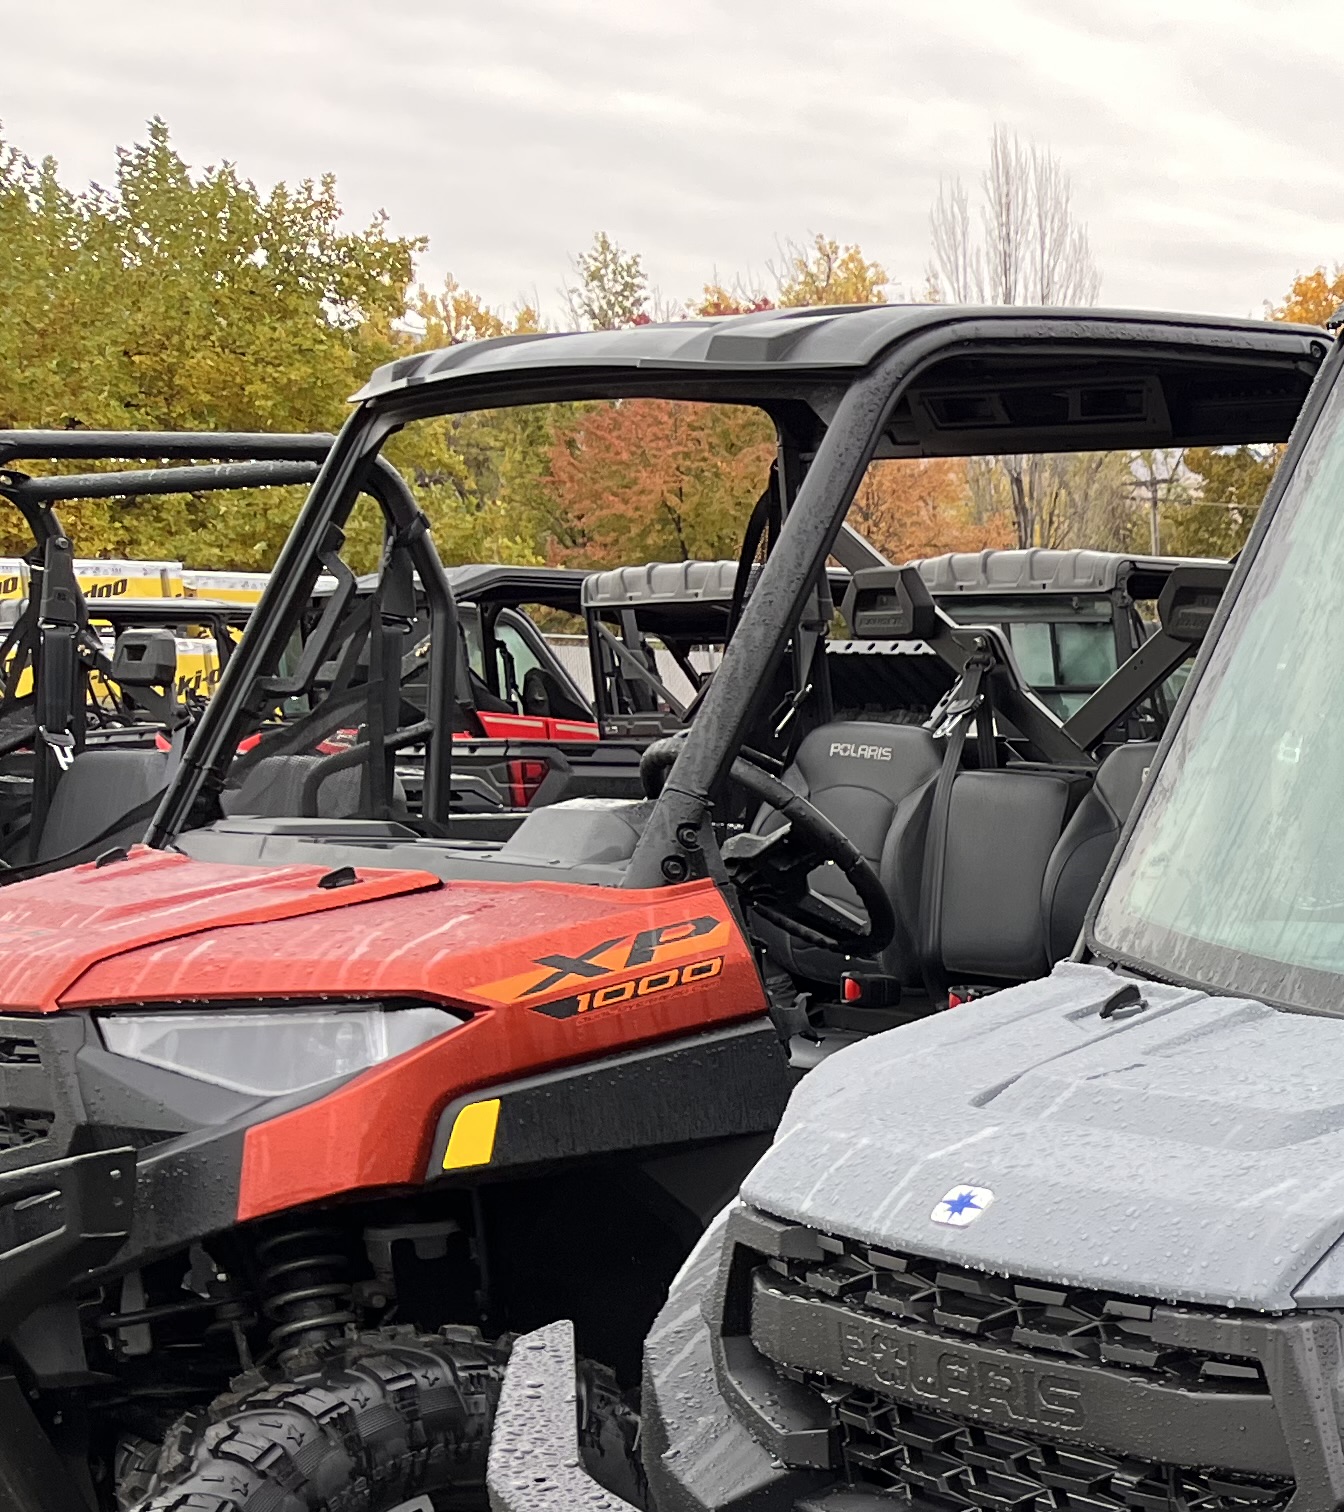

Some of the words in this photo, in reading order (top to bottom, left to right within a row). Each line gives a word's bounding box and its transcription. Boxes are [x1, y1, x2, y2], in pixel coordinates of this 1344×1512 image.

[829, 742, 893, 761] POLARIS
[516, 915, 721, 999] XP
[576, 956, 722, 1013] 1000
[836, 1321, 1088, 1432] POLARIS
